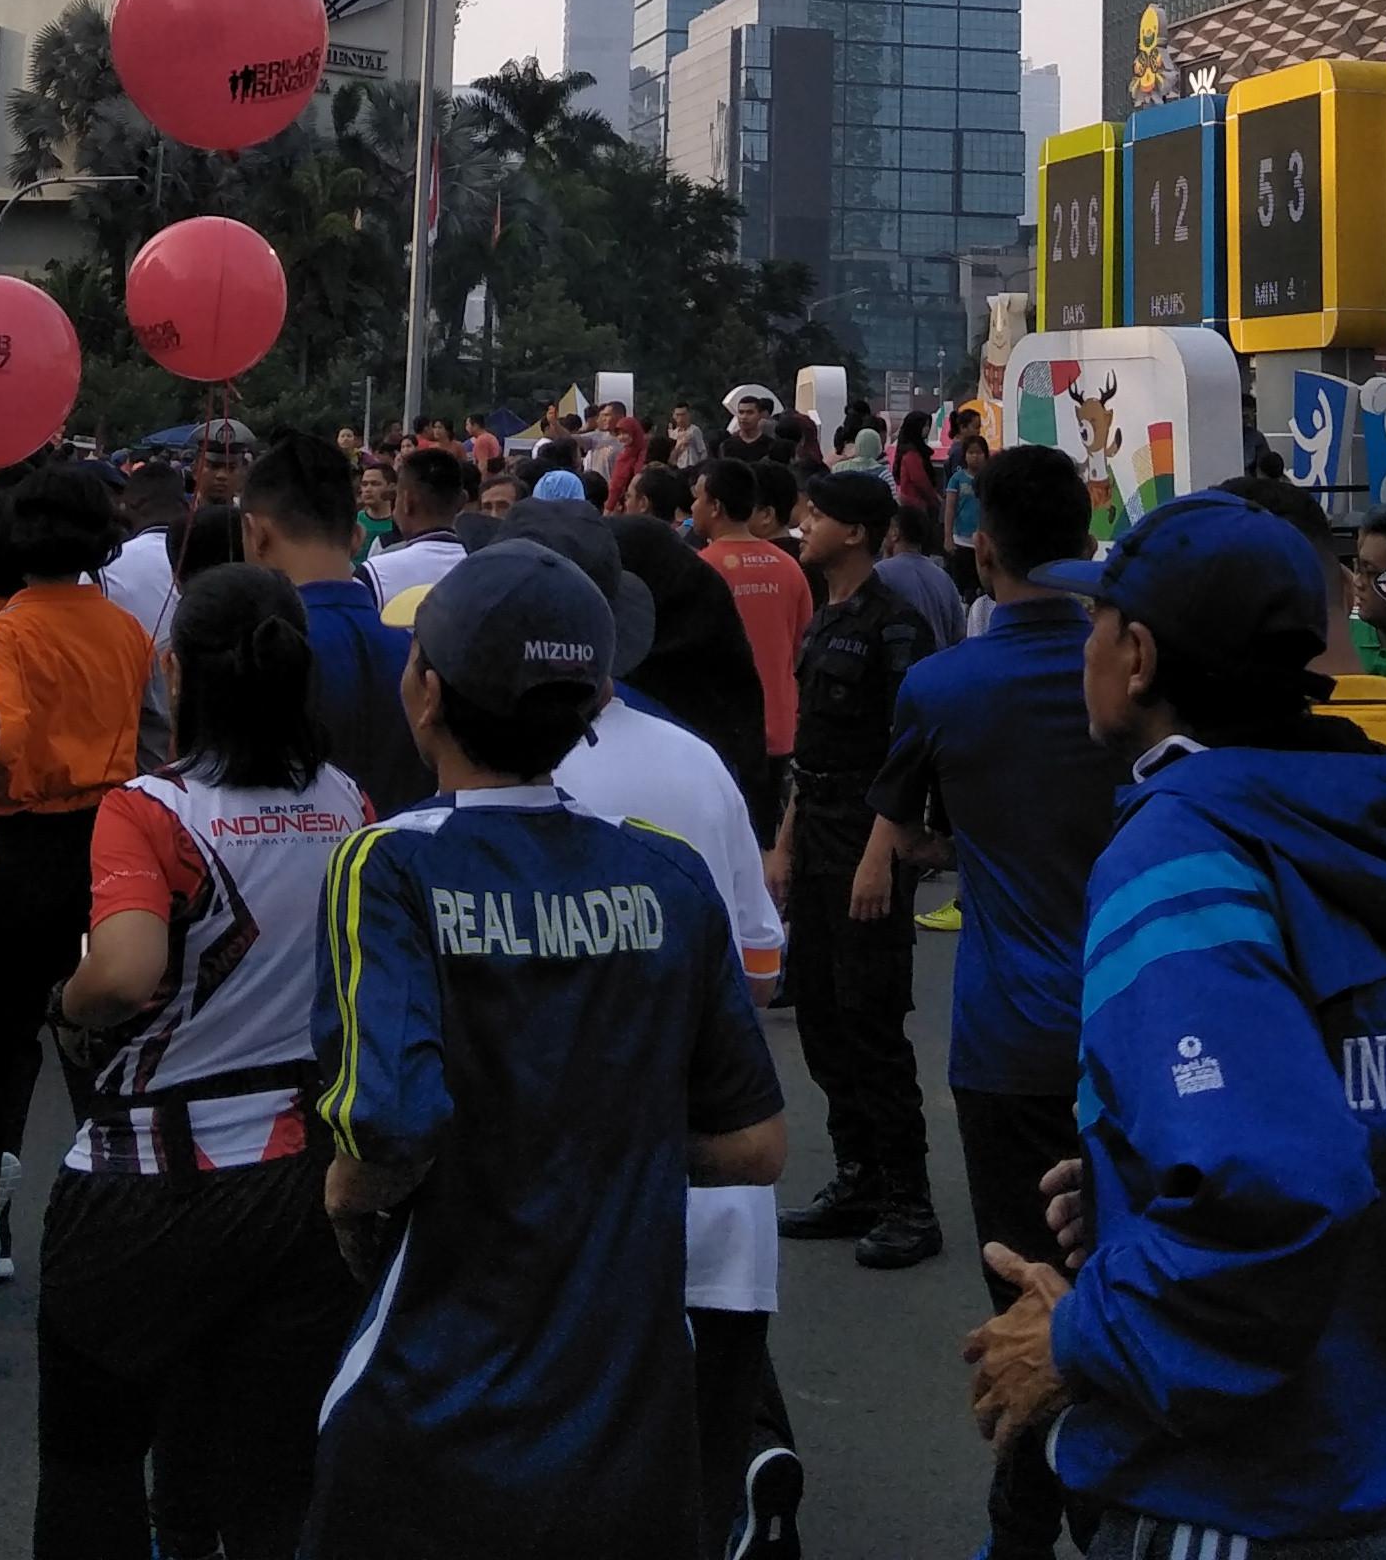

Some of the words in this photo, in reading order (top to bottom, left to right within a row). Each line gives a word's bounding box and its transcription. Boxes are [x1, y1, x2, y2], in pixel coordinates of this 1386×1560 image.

[327, 48, 388, 71] IENTAL
[1258, 149, 1305, 228] 53
[1150, 175, 1190, 245] 12
[1052, 194, 1100, 263] 286
[1150, 292, 1186, 318] HOURS
[1254, 281, 1280, 307] MIN
[1062, 303, 1086, 326] DAYS
[260, 805, 287, 815] RUN
[290, 803, 314, 814] FOR
[211, 813, 352, 837] INDONESIA
[431, 886, 533, 956] REAL
[533, 884, 663, 958] MADRID
